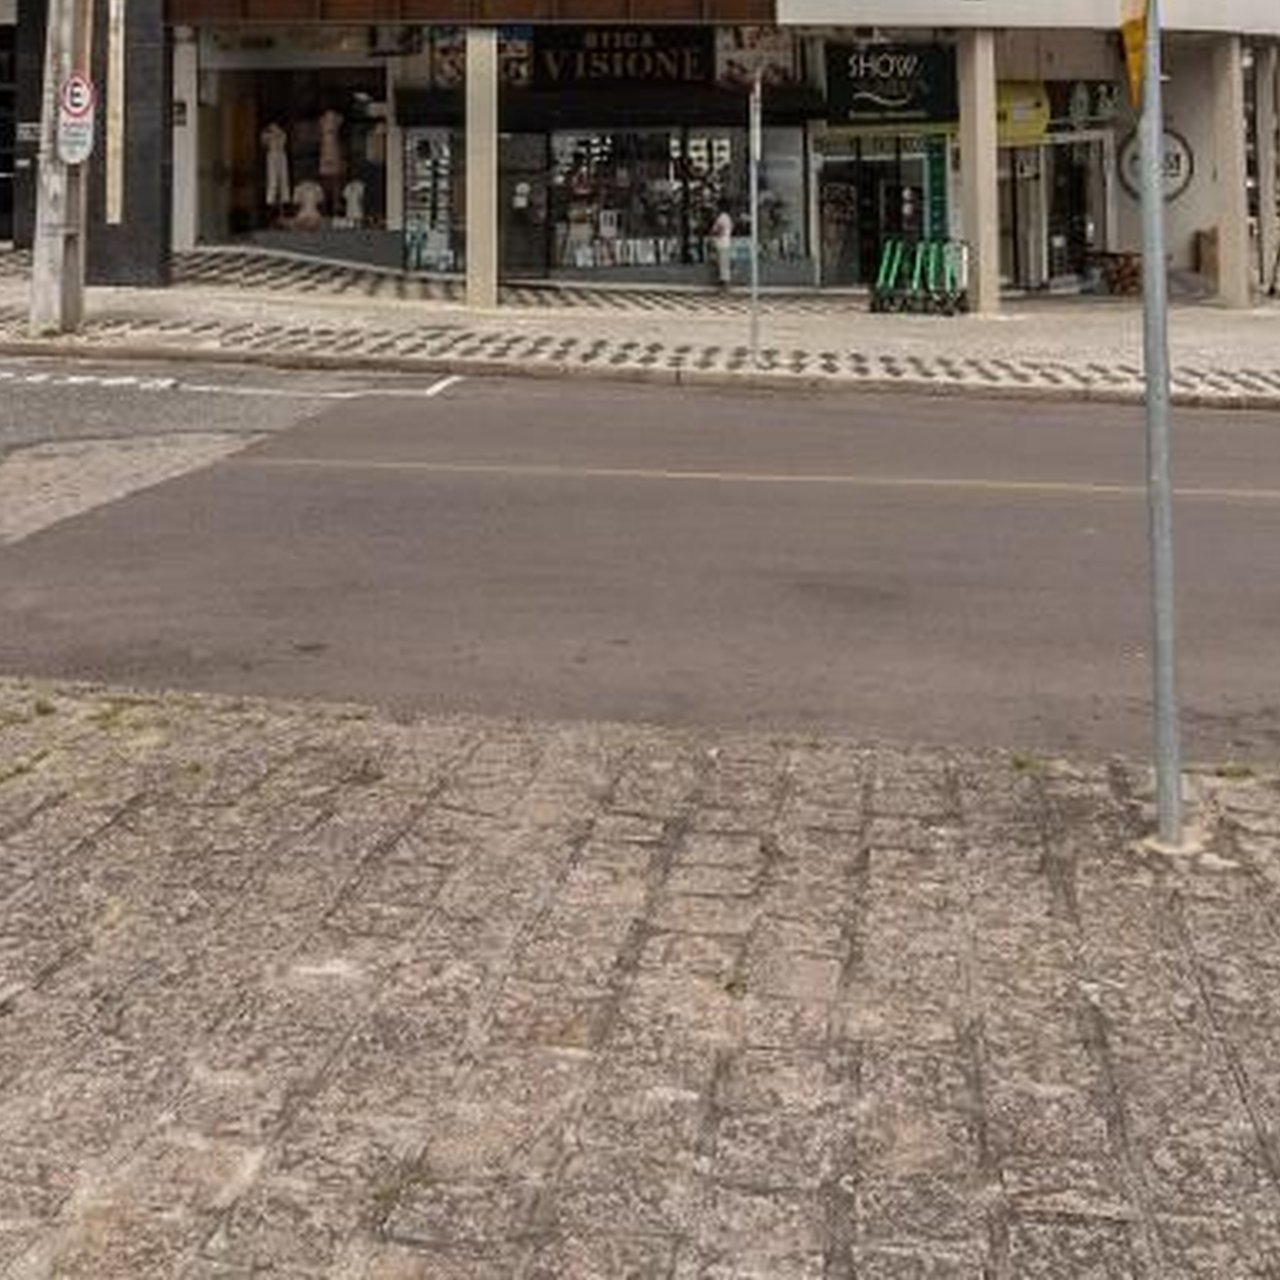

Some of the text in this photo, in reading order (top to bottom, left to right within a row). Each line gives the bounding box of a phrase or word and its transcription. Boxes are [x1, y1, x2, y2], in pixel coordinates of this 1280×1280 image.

[538, 48, 707, 82] VISIONE
[847, 52, 918, 78] SHOW
[69, 81, 83, 108] E
